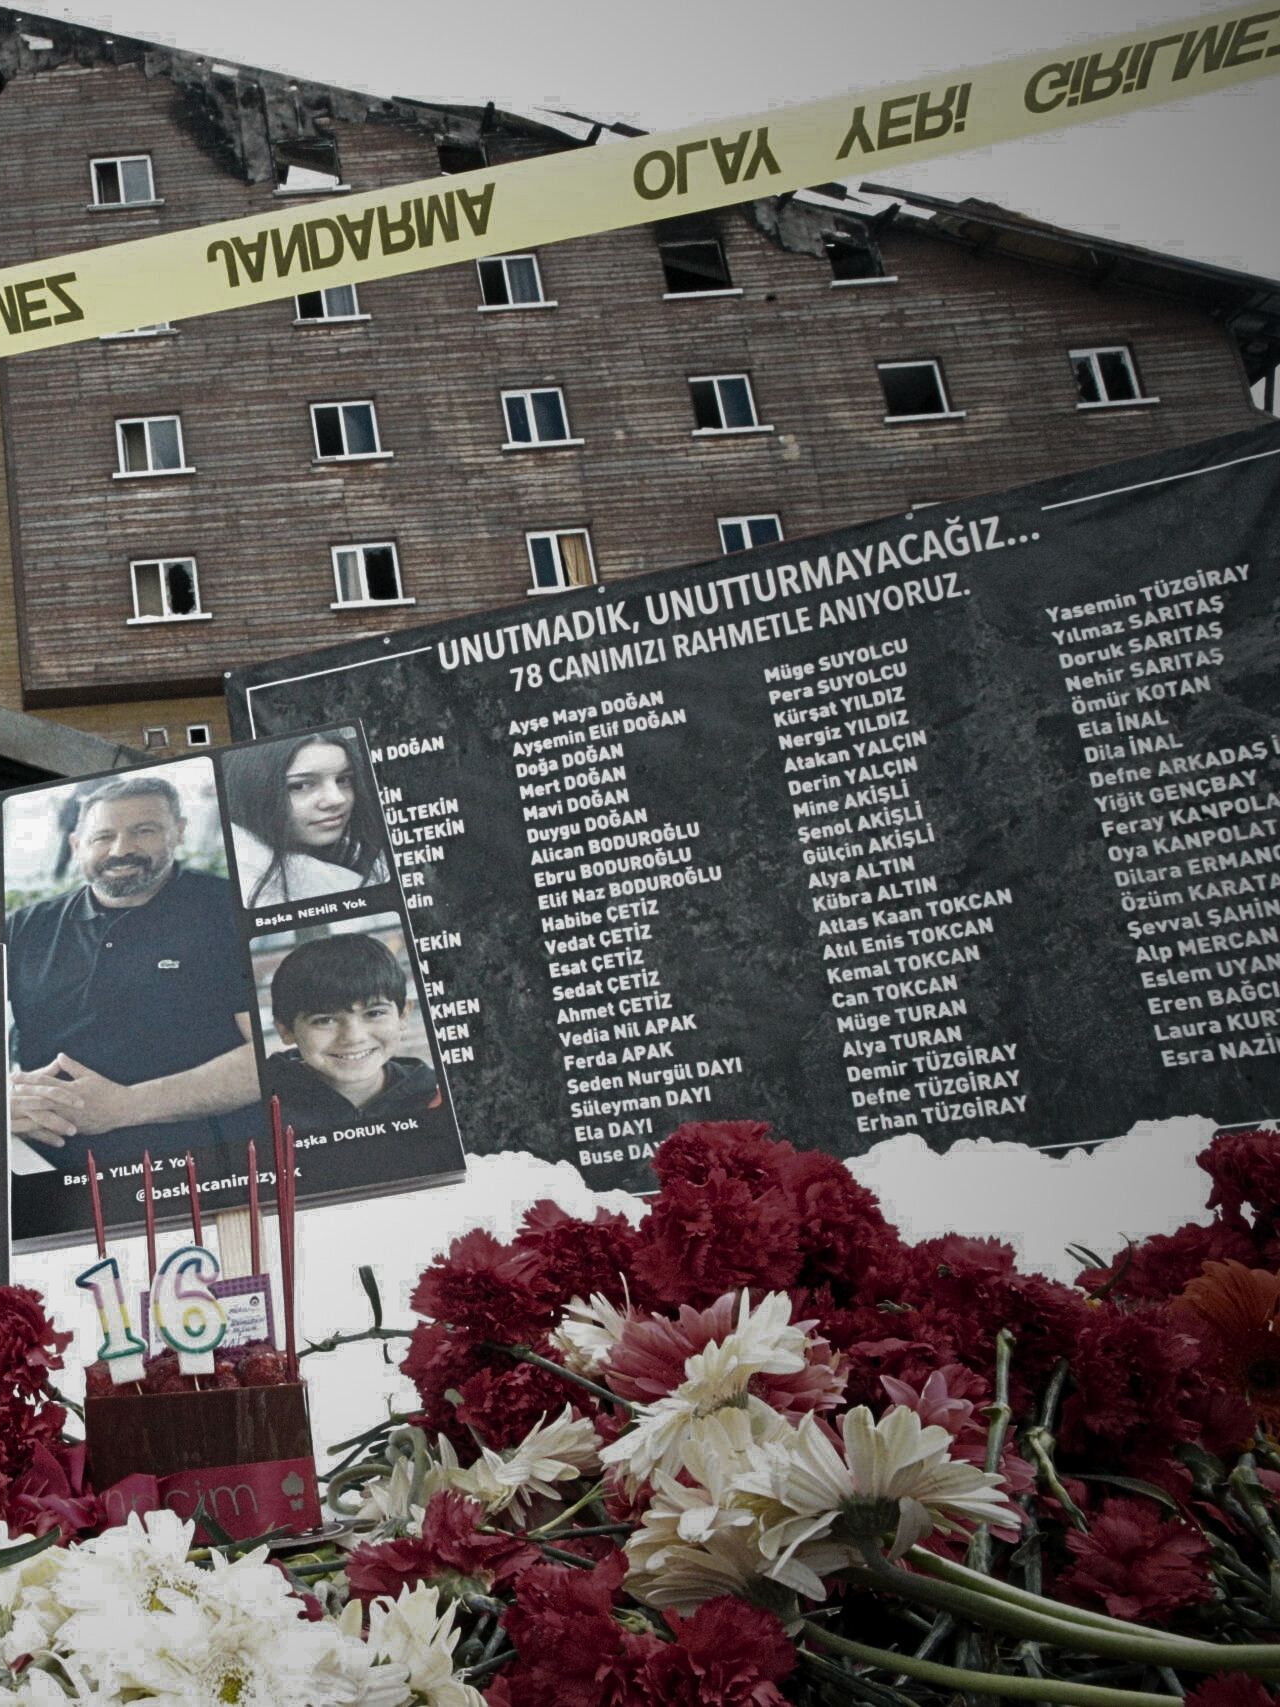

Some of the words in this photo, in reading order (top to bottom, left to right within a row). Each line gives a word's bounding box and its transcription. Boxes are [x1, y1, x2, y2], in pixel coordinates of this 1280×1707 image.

[437, 600, 640, 671] UNUTMADIK,
[644, 515, 1040, 626] UNUTTURMAYACAĞIZ...
[1045, 593, 1137, 623] Yasemin
[1139, 564, 1249, 602] TÜZGİRAY
[509, 663, 544, 693] 78
[548, 637, 667, 683] CANIMIZI
[671, 606, 813, 659] RAHMETLE
[819, 571, 971, 629] ANIYORUZ.
[1051, 620, 1125, 646] Yılmaz
[1128, 595, 1224, 630] SARITAŞ
[763, 662, 815, 684] Müge
[818, 637, 908, 672] SUYOLCU
[1058, 643, 1125, 669] Doruk
[1128, 621, 1223, 654] SARITAŞ
[768, 686, 814, 706] Pera
[816, 661, 908, 695] SUYOLCU
[1064, 668, 1125, 692] Nehir
[1129, 647, 1224, 678] SARITAŞ
[508, 716, 550, 736] Ayşe
[552, 705, 598, 726] Maya
[600, 690, 665, 716] DOĞAN
[773, 701, 839, 728] Kürşat
[839, 685, 906, 713] YILDIZ
[1071, 690, 1130, 715] Ömür
[1135, 675, 1211, 703] KOTAN
[512, 729, 586, 758] Ayşemin
[588, 720, 619, 741] Elif
[622, 708, 687, 734] DOĞAN
[778, 725, 843, 751] Nergiz
[843, 709, 910, 736] YILDIZ
[1077, 720, 1113, 739] Ela
[1115, 709, 1169, 732] İNAL
[515, 757, 559, 779] Doğa
[561, 742, 625, 769] DOĞAN
[784, 749, 851, 774] Atakan
[852, 729, 927, 759] YALÇIN
[1083, 743, 1126, 763] Dila
[1128, 733, 1184, 756] İNAL
[1089, 766, 1152, 788] Defne
[1158, 741, 1268, 777] ARKADAŞ
[519, 779, 562, 800] Mert
[563, 765, 627, 791] DOĞAN
[787, 774, 842, 796] Derin
[843, 755, 918, 785] YALÇIN
[1093, 791, 1146, 813] Yiğit
[1149, 769, 1256, 803] GENÇBAY
[522, 799, 564, 822] Mavi
[566, 787, 630, 813] DOĞAN
[792, 799, 840, 820] Mine
[844, 778, 910, 810] AKİŞLİ
[526, 822, 581, 844] Duygu
[584, 807, 648, 833] DOĞAN
[797, 817, 854, 844] Şenol
[857, 799, 924, 832] AKİŞLİ
[1101, 815, 1164, 838] Feray
[530, 845, 585, 866] Alican
[587, 821, 701, 855] BODUROĞLU
[802, 842, 864, 865] Gülçin
[868, 822, 935, 854] AKİŞLİ
[1107, 845, 1149, 864] Oya
[1152, 819, 1276, 855] KANPOLAT
[533, 869, 577, 888] Ebru
[579, 846, 692, 880] BODUROĞLU
[808, 870, 851, 890] Alya
[855, 855, 916, 881] ALTIN
[1114, 865, 1183, 887] Dilara
[537, 890, 568, 911] Elif
[571, 887, 606, 905] Naz
[608, 865, 723, 898] BODUROĞLU
[811, 891, 873, 913] Kübra
[877, 875, 938, 902] ALTIN
[1121, 890, 1184, 912] Özüm
[255, 913, 293, 927] Başka
[298, 903, 338, 919] NEHİR
[342, 898, 367, 911] Yok
[541, 911, 603, 933] Habibe
[606, 897, 660, 923] ÇETİZ
[818, 916, 869, 937] Atlas
[871, 907, 923, 928] Kaan
[925, 888, 1013, 917] TOKCAN
[1127, 911, 1204, 940] Şevval
[543, 933, 596, 956] Vedat
[599, 921, 653, 948] ÇETİZ
[822, 940, 858, 961] Atıl
[861, 933, 905, 954] Enis
[907, 916, 994, 946] TOKCAN
[1135, 944, 1173, 964] Alp
[1177, 926, 1279, 957] MERCAN
[548, 958, 588, 979] Esat
[591, 946, 645, 973] ÇETİZ
[826, 959, 892, 985] Kemal
[893, 944, 981, 973] TOKCAN
[552, 979, 604, 1002] Sedat
[606, 967, 661, 995] ÇETİZ
[831, 991, 870, 1009] Can
[871, 974, 958, 1002] TOKCAN
[556, 1002, 616, 1025] Ahmet
[618, 990, 673, 1017] ÇETİZ
[836, 1012, 891, 1033] Müge
[894, 998, 968, 1024] TURAN
[1147, 996, 1203, 1015] Eren
[558, 1027, 610, 1048] Vedia
[613, 1021, 641, 1040] Nil
[644, 1013, 698, 1036] APAK
[842, 1039, 887, 1059] Alya
[889, 1025, 963, 1051] TURAN
[563, 1050, 618, 1072] Ferda
[621, 1040, 674, 1064] APAK
[566, 1075, 624, 1095] Seden
[627, 1063, 694, 1087] Nurgül
[695, 1056, 743, 1078] DAYI
[846, 1060, 908, 1083] Demir
[911, 1043, 1017, 1073] TÜZGİRAY
[570, 1095, 662, 1119] Süleyman
[665, 1085, 712, 1107] DAYI
[851, 1087, 911, 1108] Defne
[914, 1069, 1020, 1099] TÜZGİRAY
[332, 1123, 387, 1142] DORUK
[391, 1118, 419, 1132] Yok
[574, 1125, 605, 1143] Ela
[607, 1117, 653, 1138] DAYI
[856, 1113, 918, 1133] Erhan
[920, 1094, 1027, 1124] TÜZGİRAY
[578, 1149, 624, 1166] Buse
[75, 1246, 227, 1361] 16
